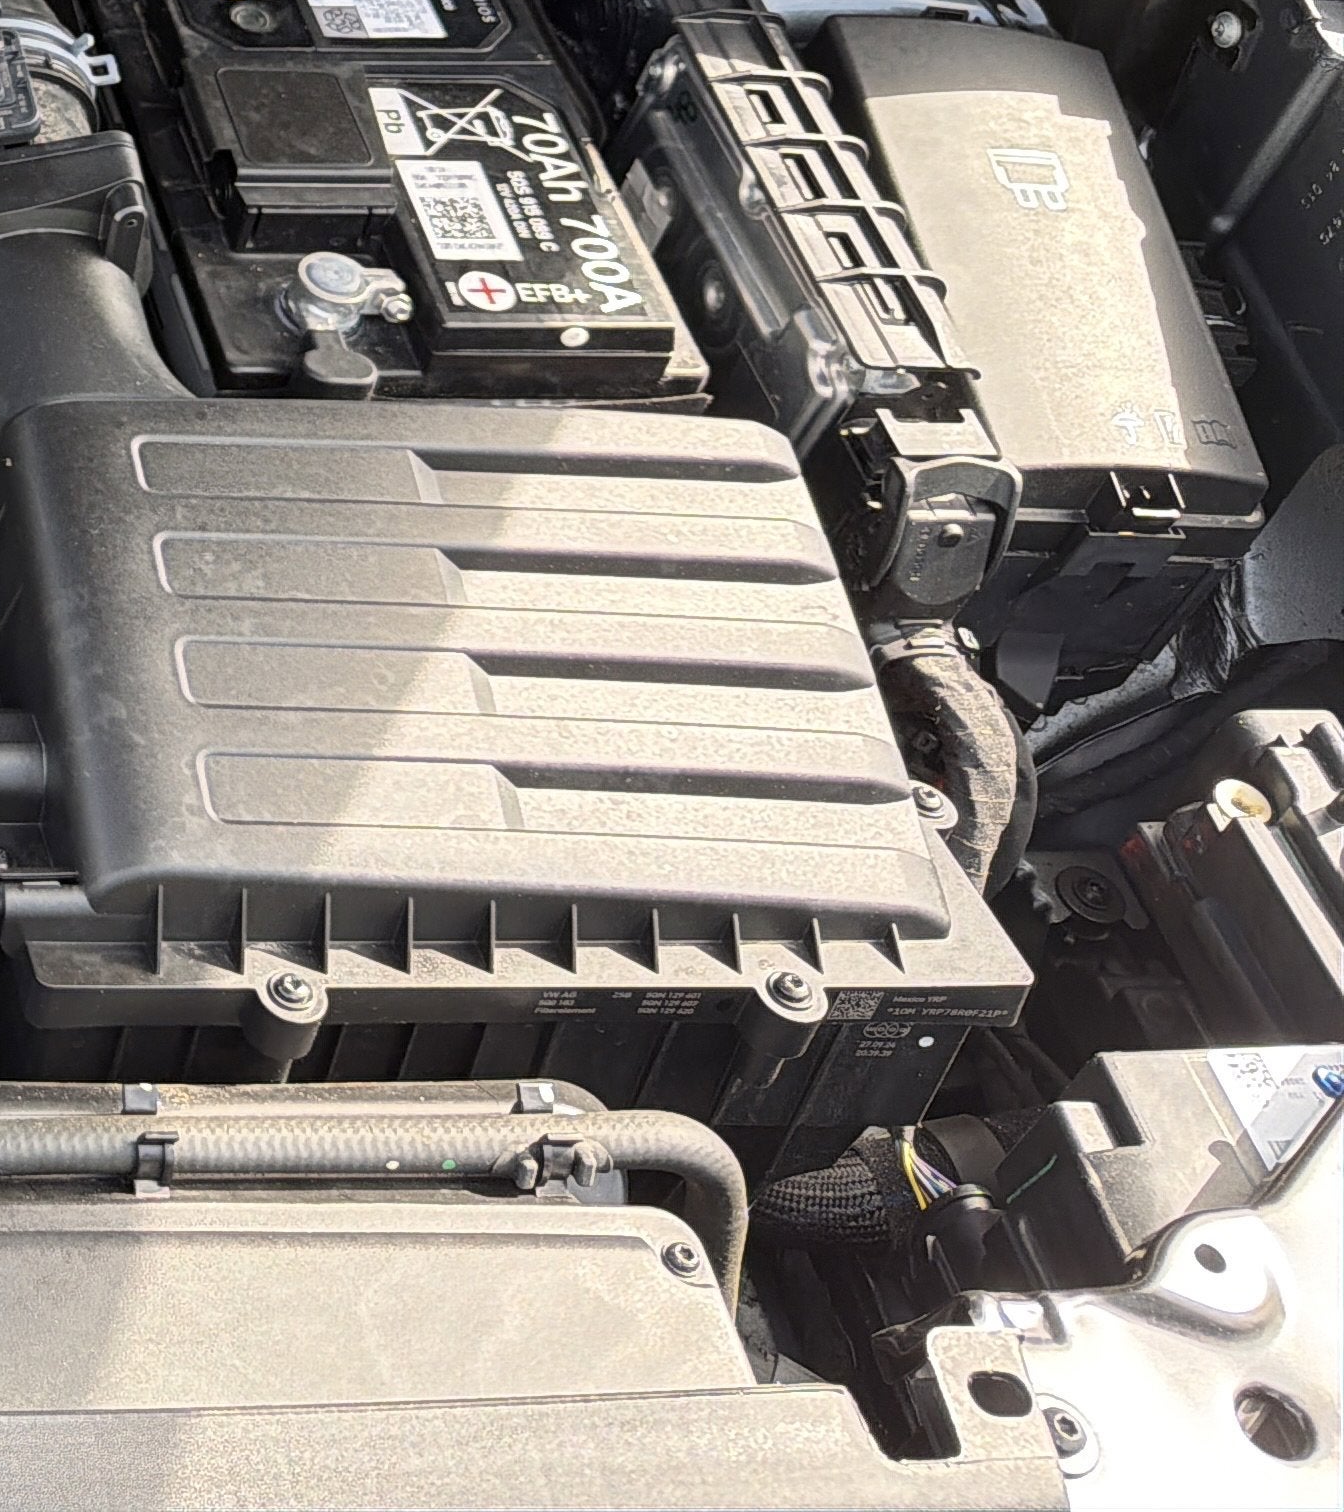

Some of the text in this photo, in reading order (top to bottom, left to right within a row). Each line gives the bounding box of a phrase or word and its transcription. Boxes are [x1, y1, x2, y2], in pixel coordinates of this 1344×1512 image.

[377, 108, 403, 134] Pb
[512, 113, 643, 314] 70Ah 700A
